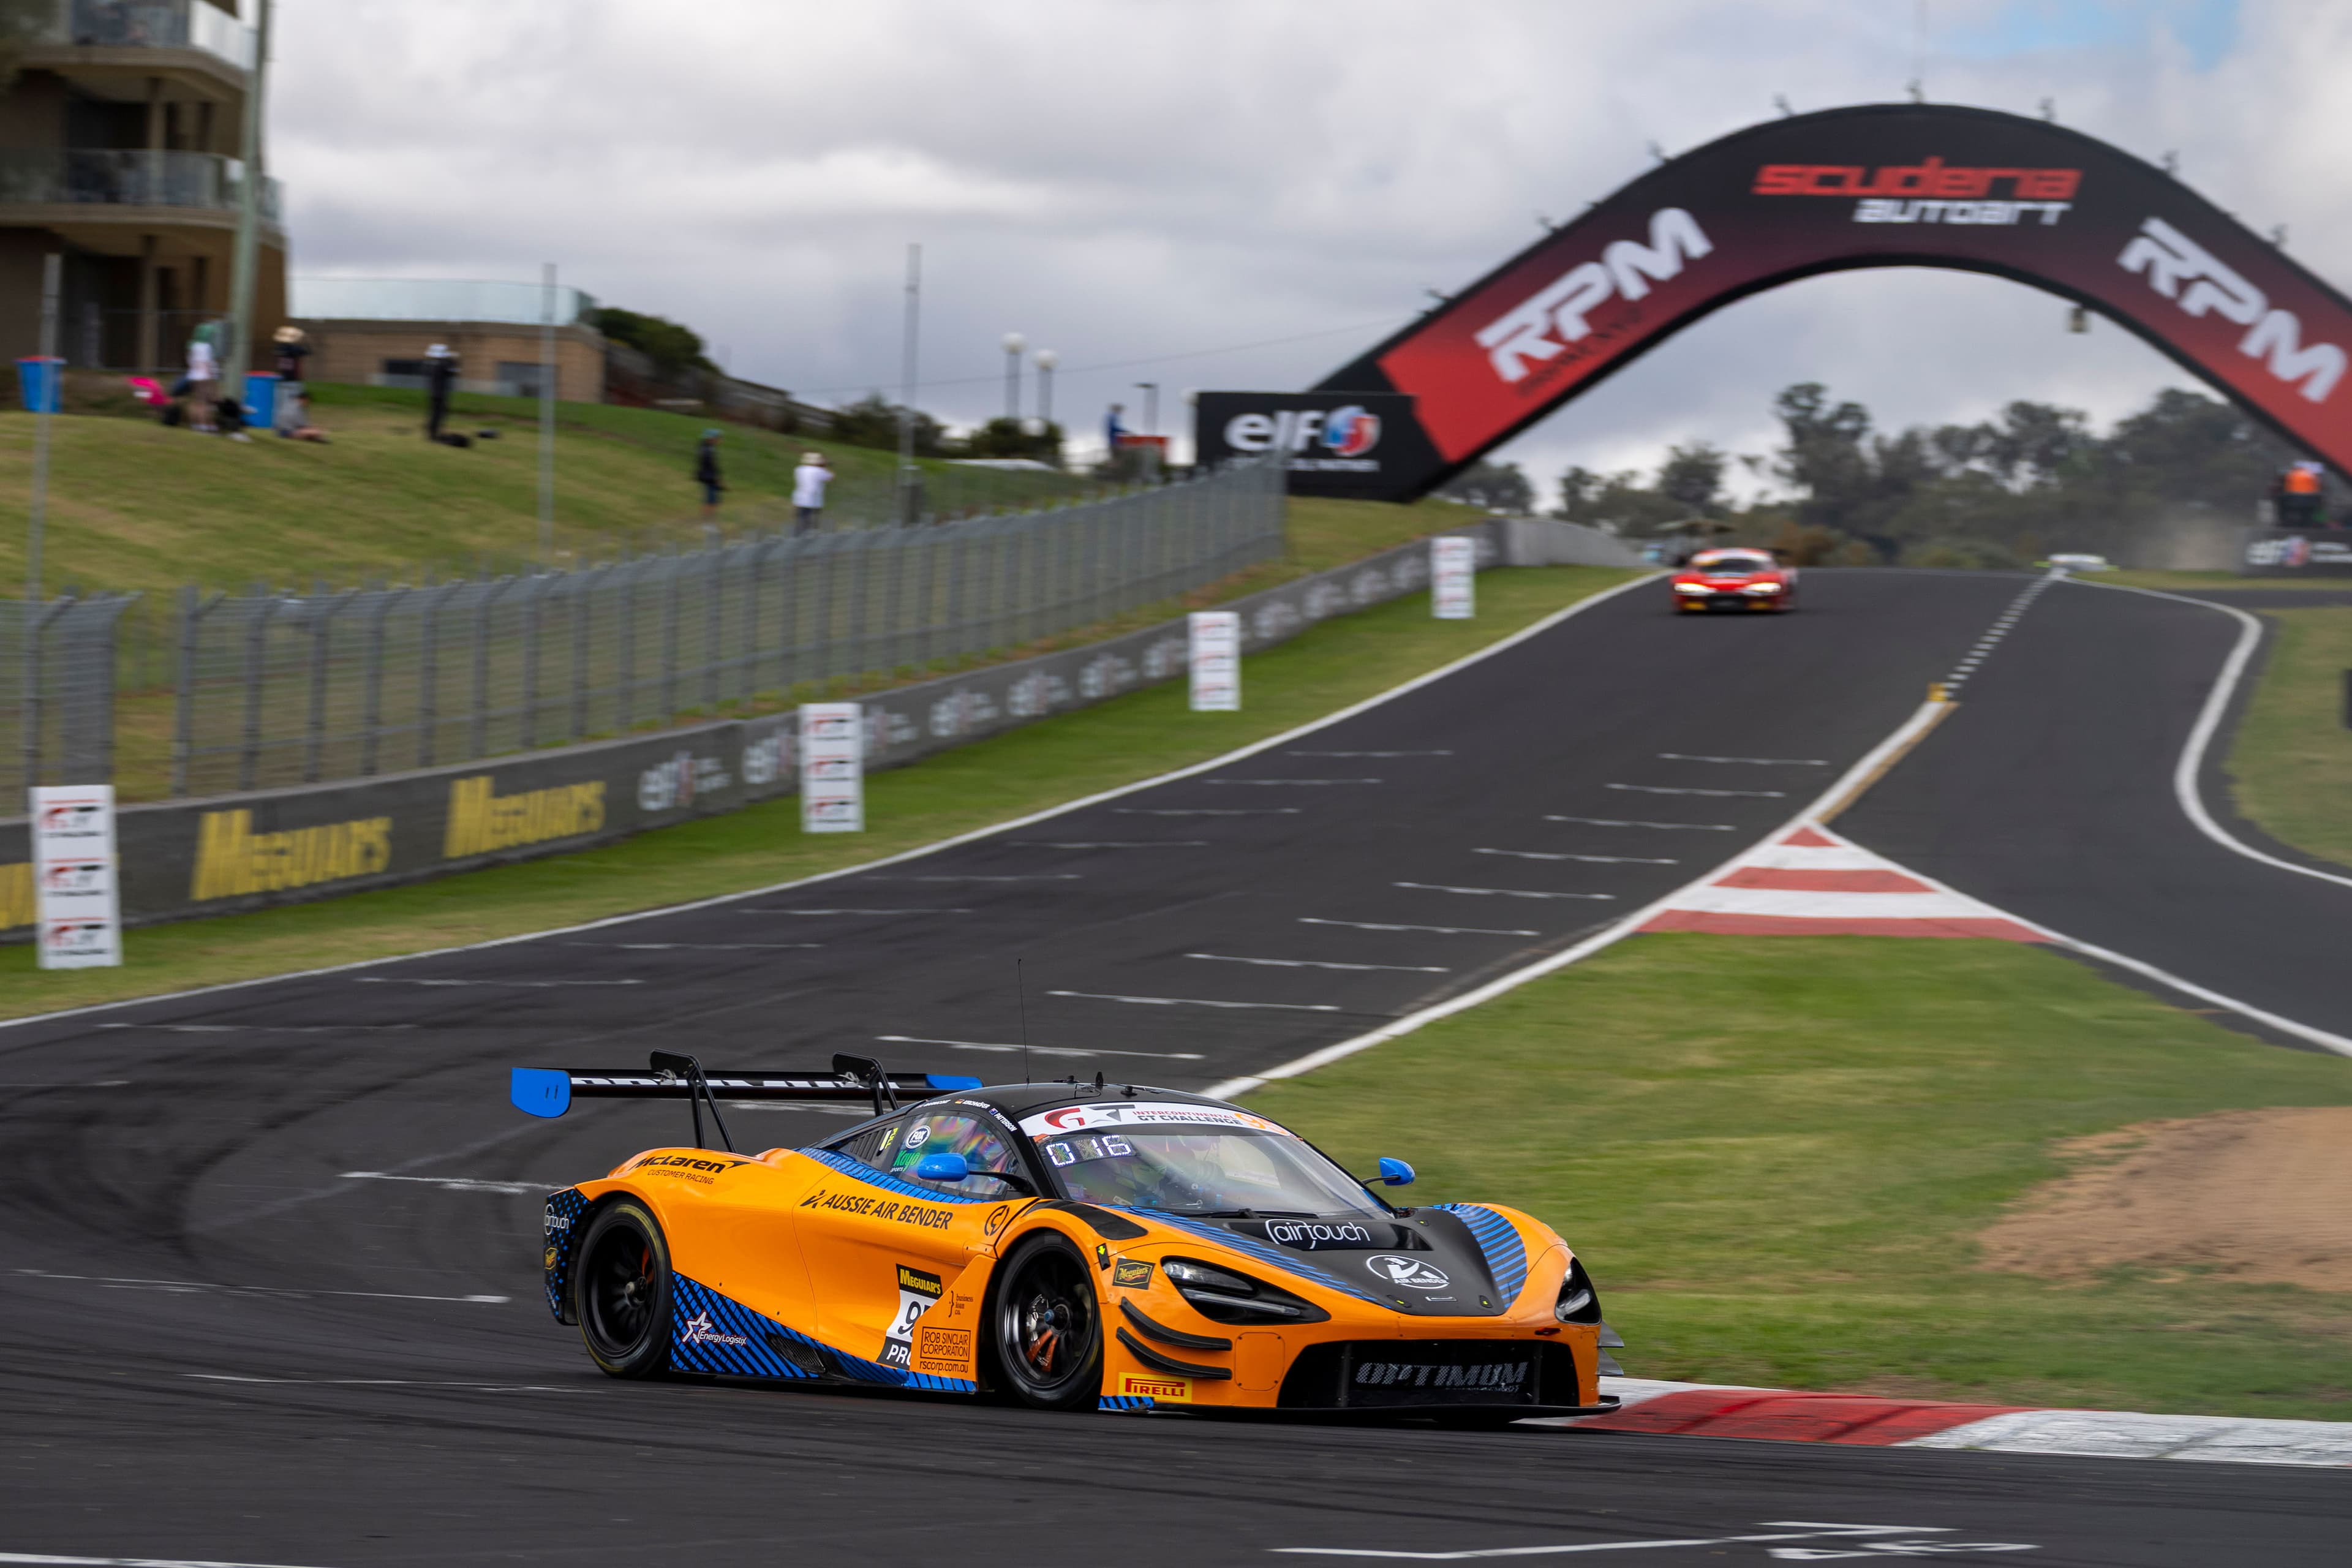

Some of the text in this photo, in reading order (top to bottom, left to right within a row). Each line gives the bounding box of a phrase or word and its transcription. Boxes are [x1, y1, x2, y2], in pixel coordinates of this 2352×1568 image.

[1473, 207, 1714, 383] RPM
[2116, 216, 2347, 404] RPM
[1224, 409, 1327, 452] elf
[993, 1113, 1017, 1131] PATTERSON
[1133, 1110, 1236, 1120] INTERCONTINENTAL
[1160, 1115, 1244, 1125] CHALLENGE
[911, 1131, 927, 1140] FOX
[627, 1155, 727, 1174] McLaren
[894, 1150, 921, 1172] Kayo
[647, 1169, 715, 1185] CUSTOMER RACING
[821, 1194, 954, 1230] AUSSIE AIR BENDER
[1268, 1219, 1371, 1244] airtouch
[900, 1268, 941, 1294] MEGUIAR'S
[924, 1332, 968, 1346] ROB SINCLAIR
[922, 1344, 968, 1357] CORPORATION
[919, 1360, 968, 1374] rscorp.com.au
[1355, 1362, 1529, 1386] OPTIMUM
[1125, 1378, 1186, 1396] PIRELLI
